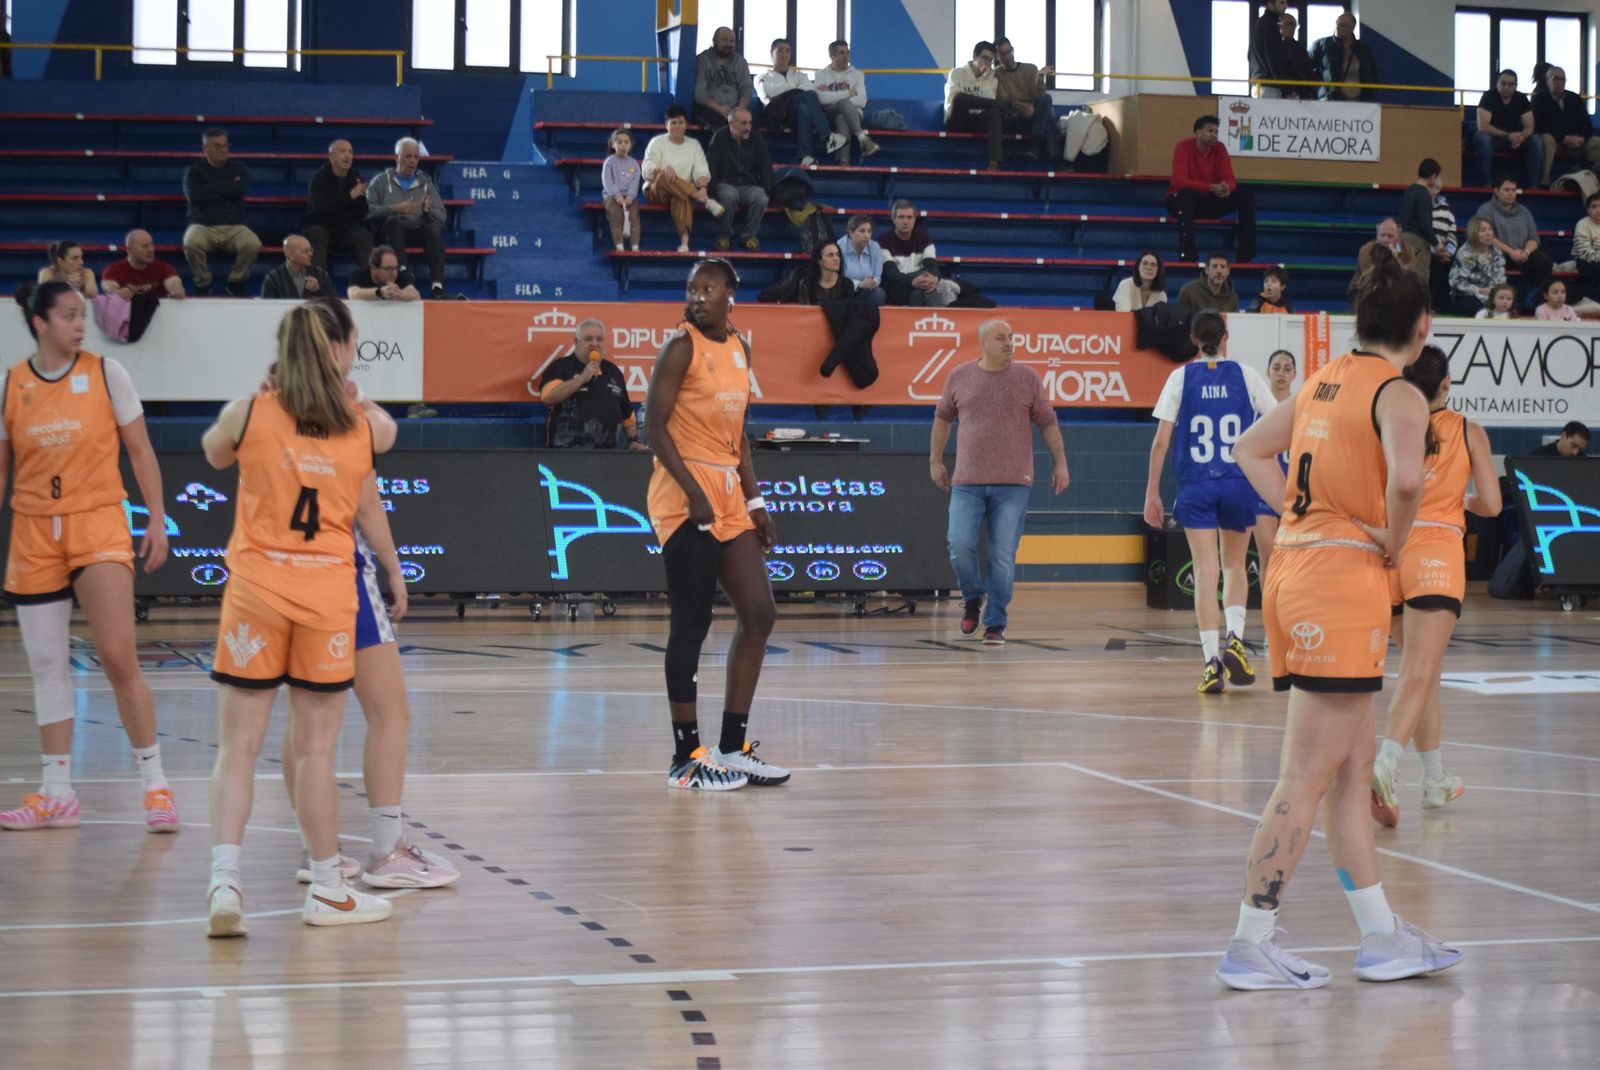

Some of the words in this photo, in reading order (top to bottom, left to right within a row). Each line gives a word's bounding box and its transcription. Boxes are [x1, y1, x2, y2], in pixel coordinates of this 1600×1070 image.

[1258, 116, 1374, 134] AYUNTAMIENTO
[1258, 134, 1281, 152] DE
[1286, 135, 1373, 156] ZAMORA
[503, 169, 511, 180] 6
[534, 237, 542, 248] 4
[1201, 385, 1228, 399] AINA
[1190, 413, 1241, 464] 39
[51, 475, 62, 500] 8
[757, 475, 885, 496] coletas
[1291, 452, 1312, 517] 9
[290, 486, 321, 542] 4
[765, 500, 854, 513] amora
